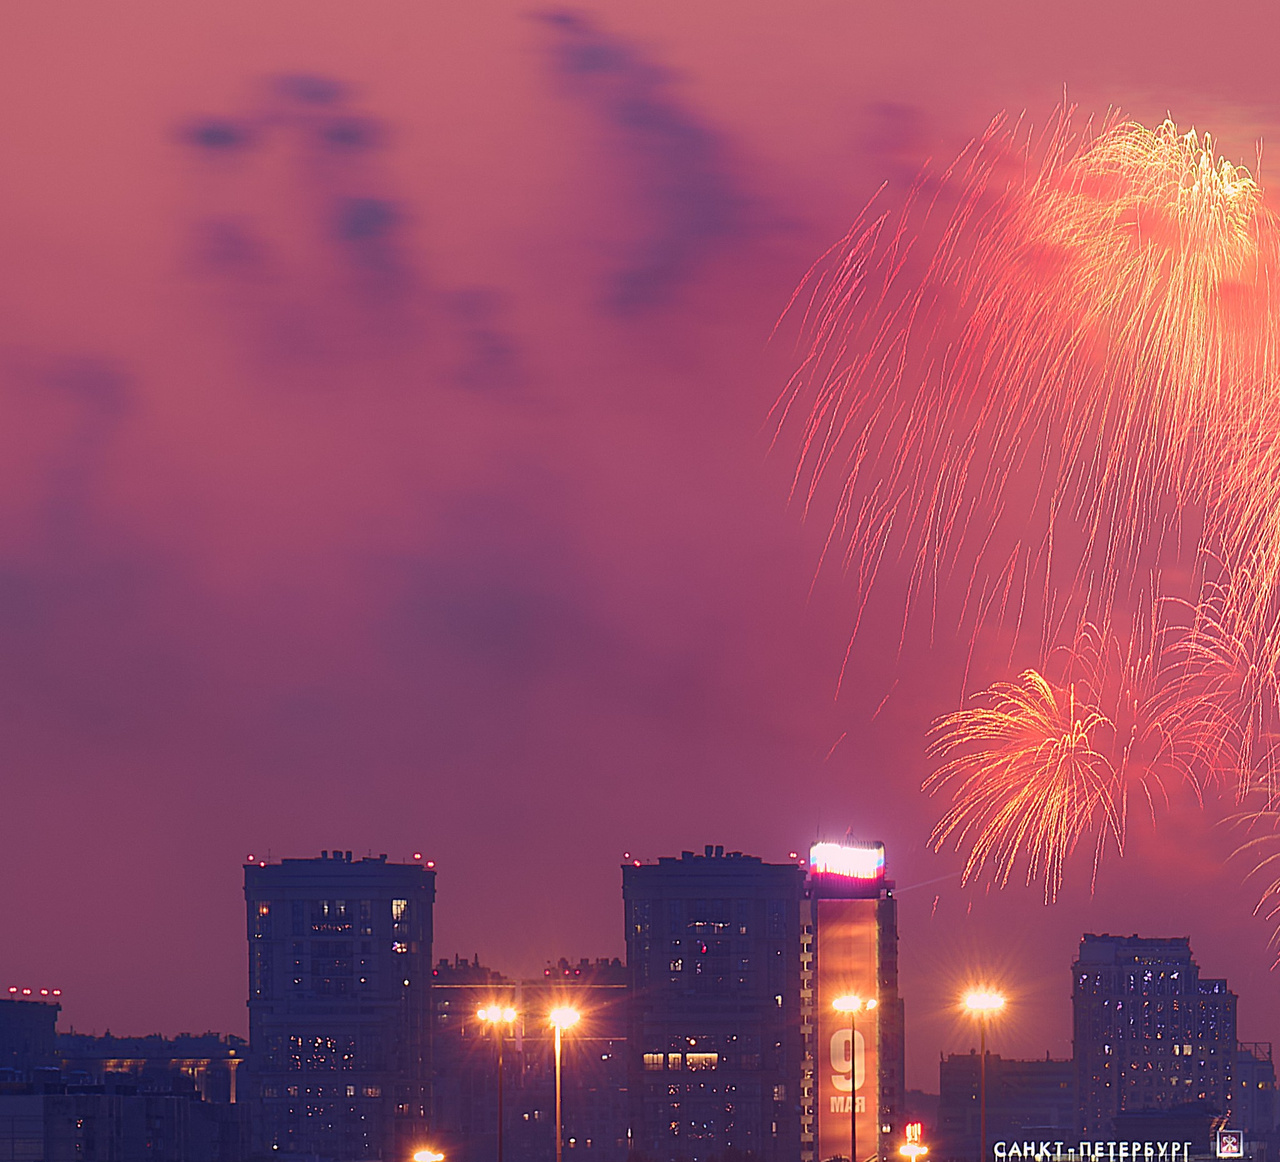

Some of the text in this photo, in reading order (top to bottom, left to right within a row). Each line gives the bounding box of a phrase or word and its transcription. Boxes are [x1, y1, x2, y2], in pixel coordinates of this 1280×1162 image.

[830, 1028, 866, 1092] 9
[829, 1096, 866, 1113] МАЯ
[993, 1141, 1193, 1158] САНКТ-ПЕТЕРБУРГ
